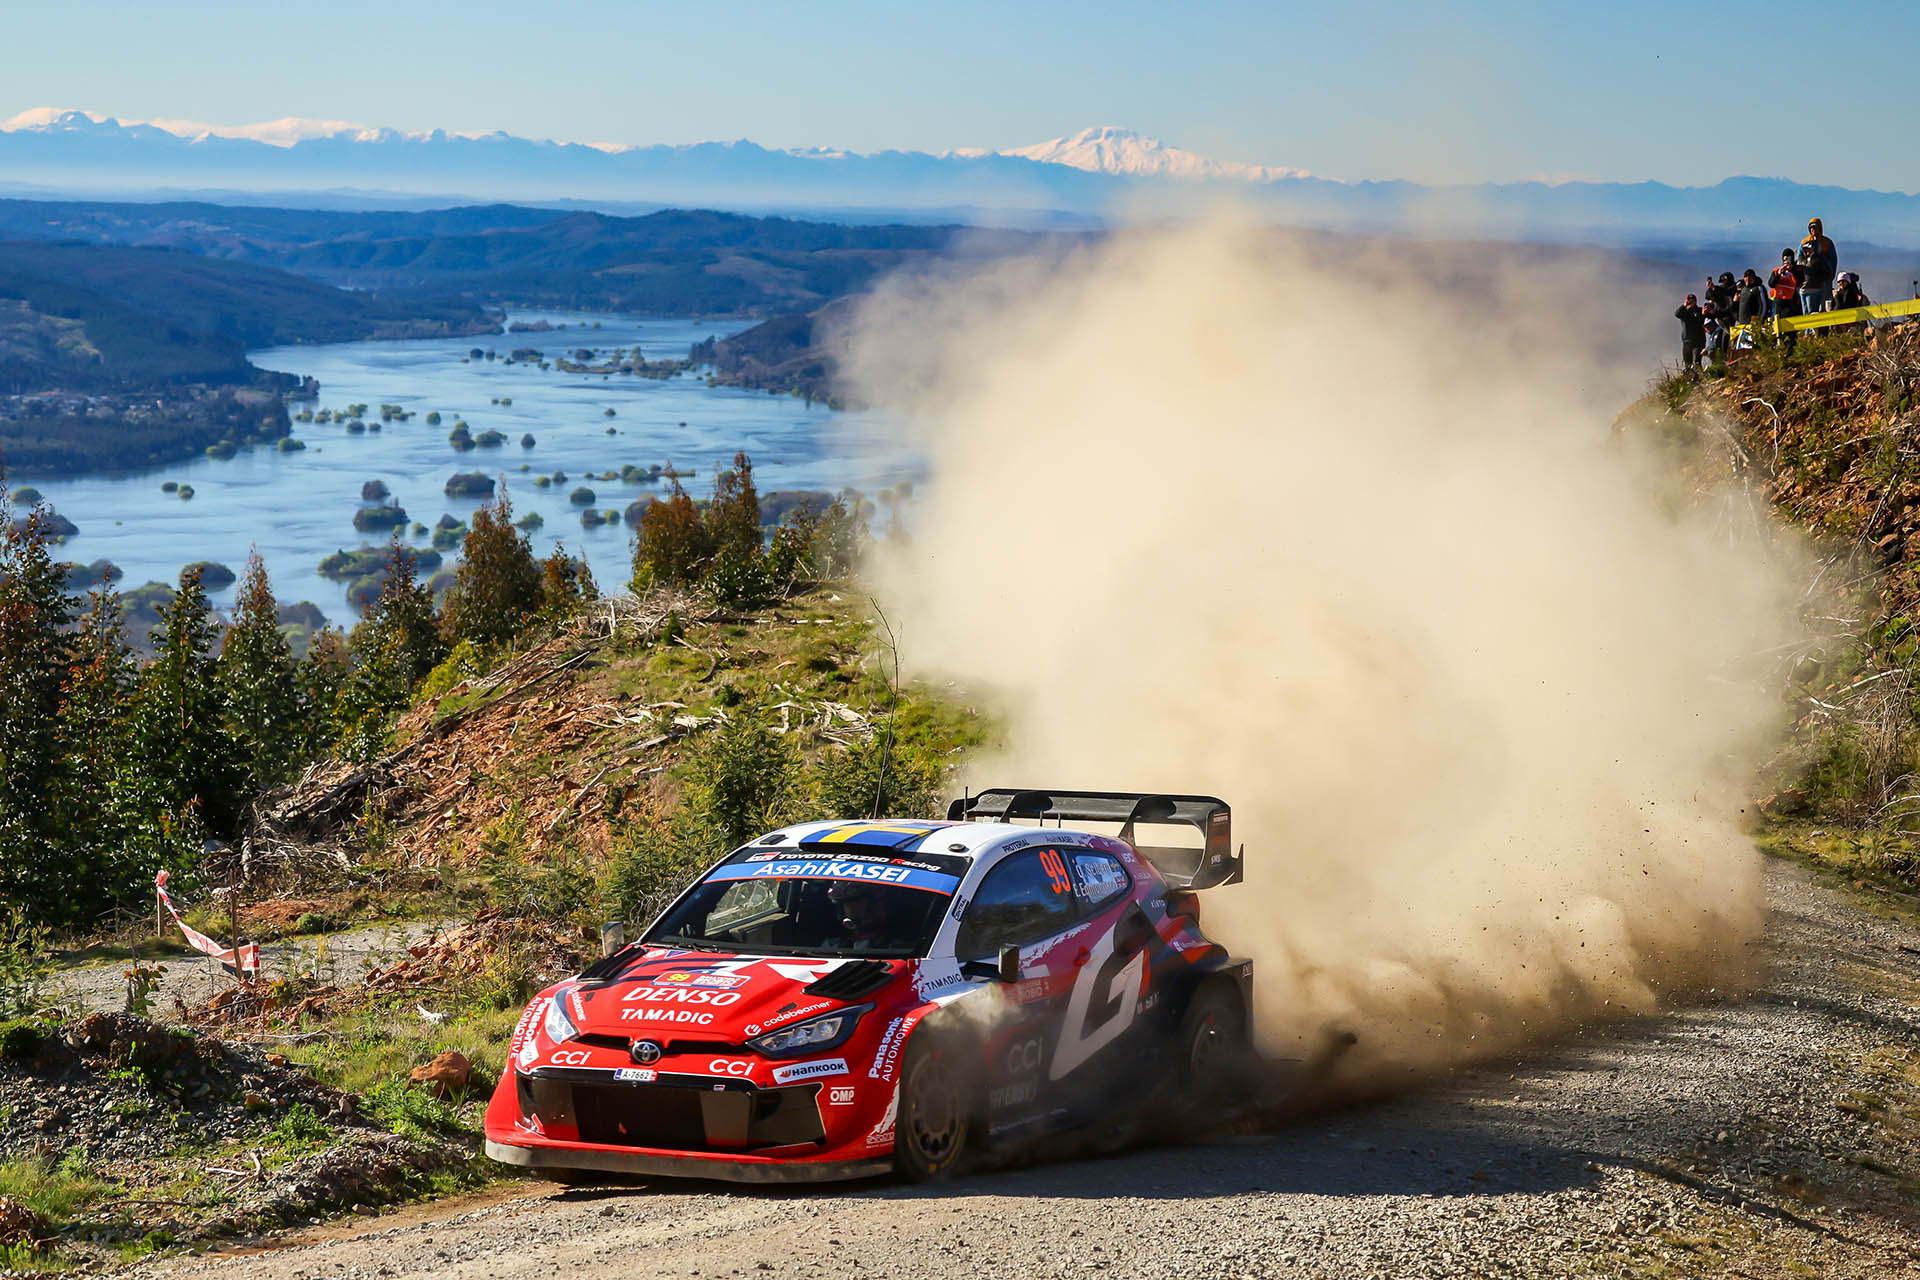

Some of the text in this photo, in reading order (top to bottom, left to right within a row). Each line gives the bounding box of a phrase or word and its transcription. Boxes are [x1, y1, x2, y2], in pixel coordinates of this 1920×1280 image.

[751, 861, 911, 882] AsahiKASEI
[835, 853, 890, 862] GAZOO
[890, 857, 941, 871] Racing
[1040, 849, 1071, 894] 99
[667, 973, 691, 982] 99
[925, 973, 962, 991] TAMADIC
[621, 987, 741, 1006] DENSO
[621, 1008, 714, 1025] TAMADIC
[763, 1000, 832, 1028] codebeamer
[510, 996, 542, 1059] AUTOMOTIVE
[868, 1016, 904, 1079] Panasonic
[882, 1016, 917, 1082] AUTOMOTIVE
[622, 1070, 650, 1080] A-7662
[829, 1089, 855, 1102] OMP
